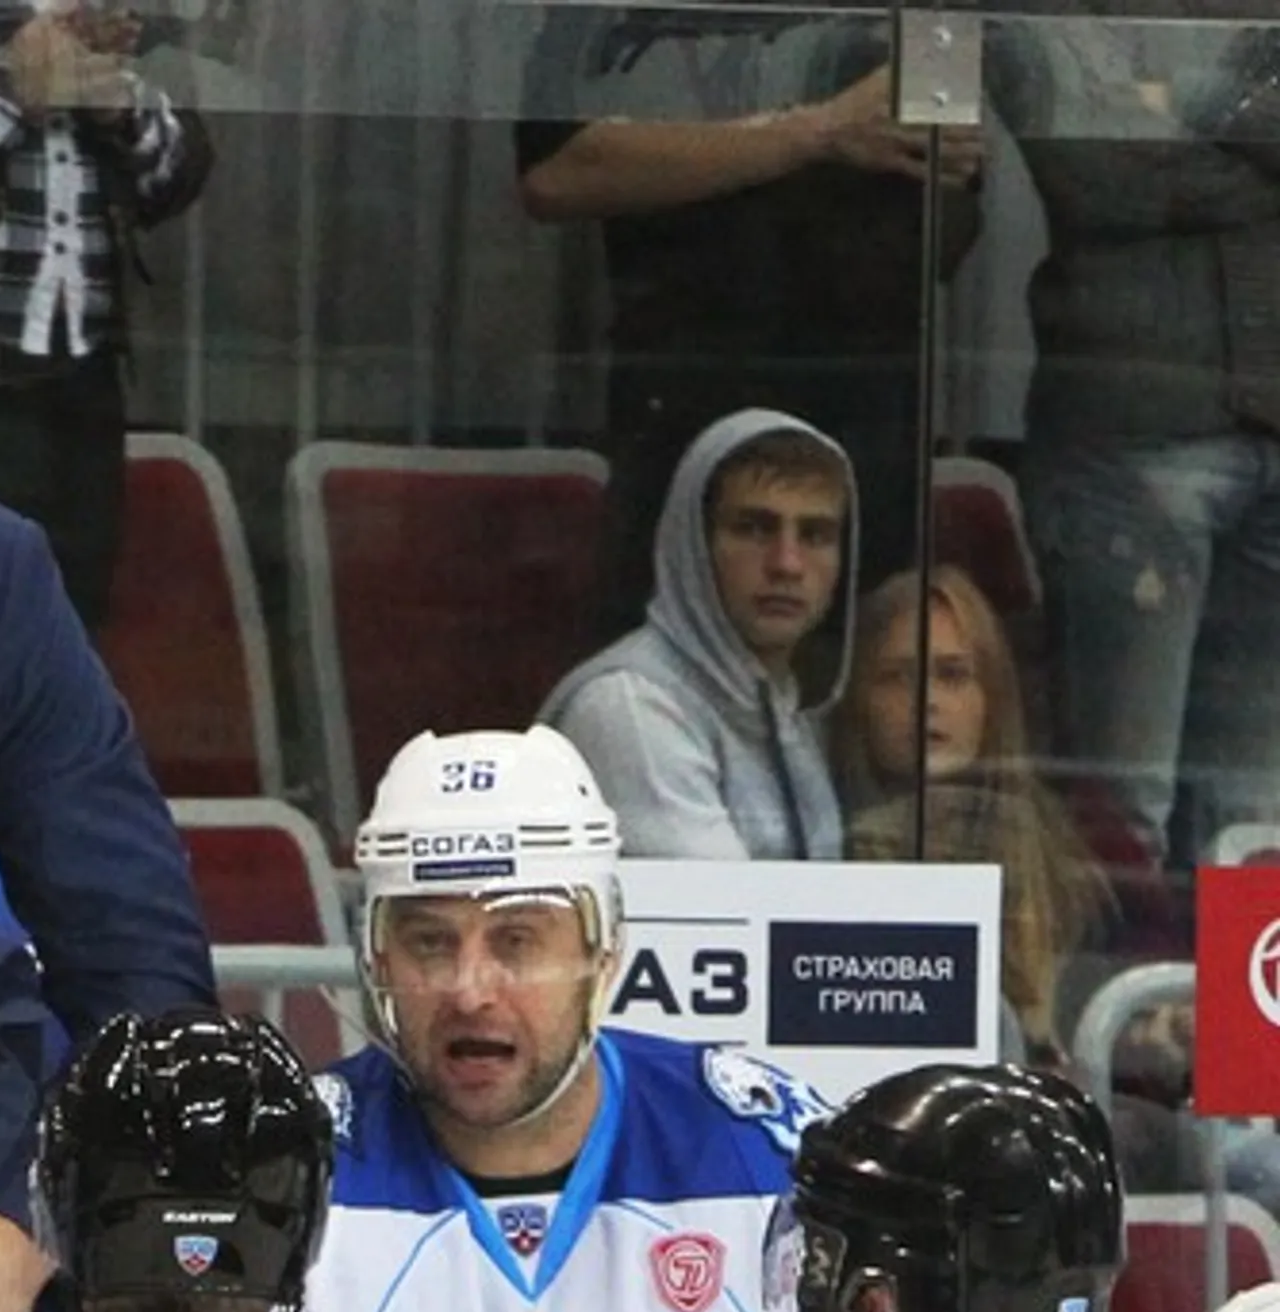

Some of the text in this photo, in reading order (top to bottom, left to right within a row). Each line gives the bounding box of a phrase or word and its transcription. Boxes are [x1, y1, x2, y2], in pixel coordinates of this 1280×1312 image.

[441, 759, 496, 793] 36
[411, 832, 516, 857] СОГАЗ
[791, 955, 955, 983] СТРАХОВАЯ
[817, 989, 927, 1015] ГРУППА
